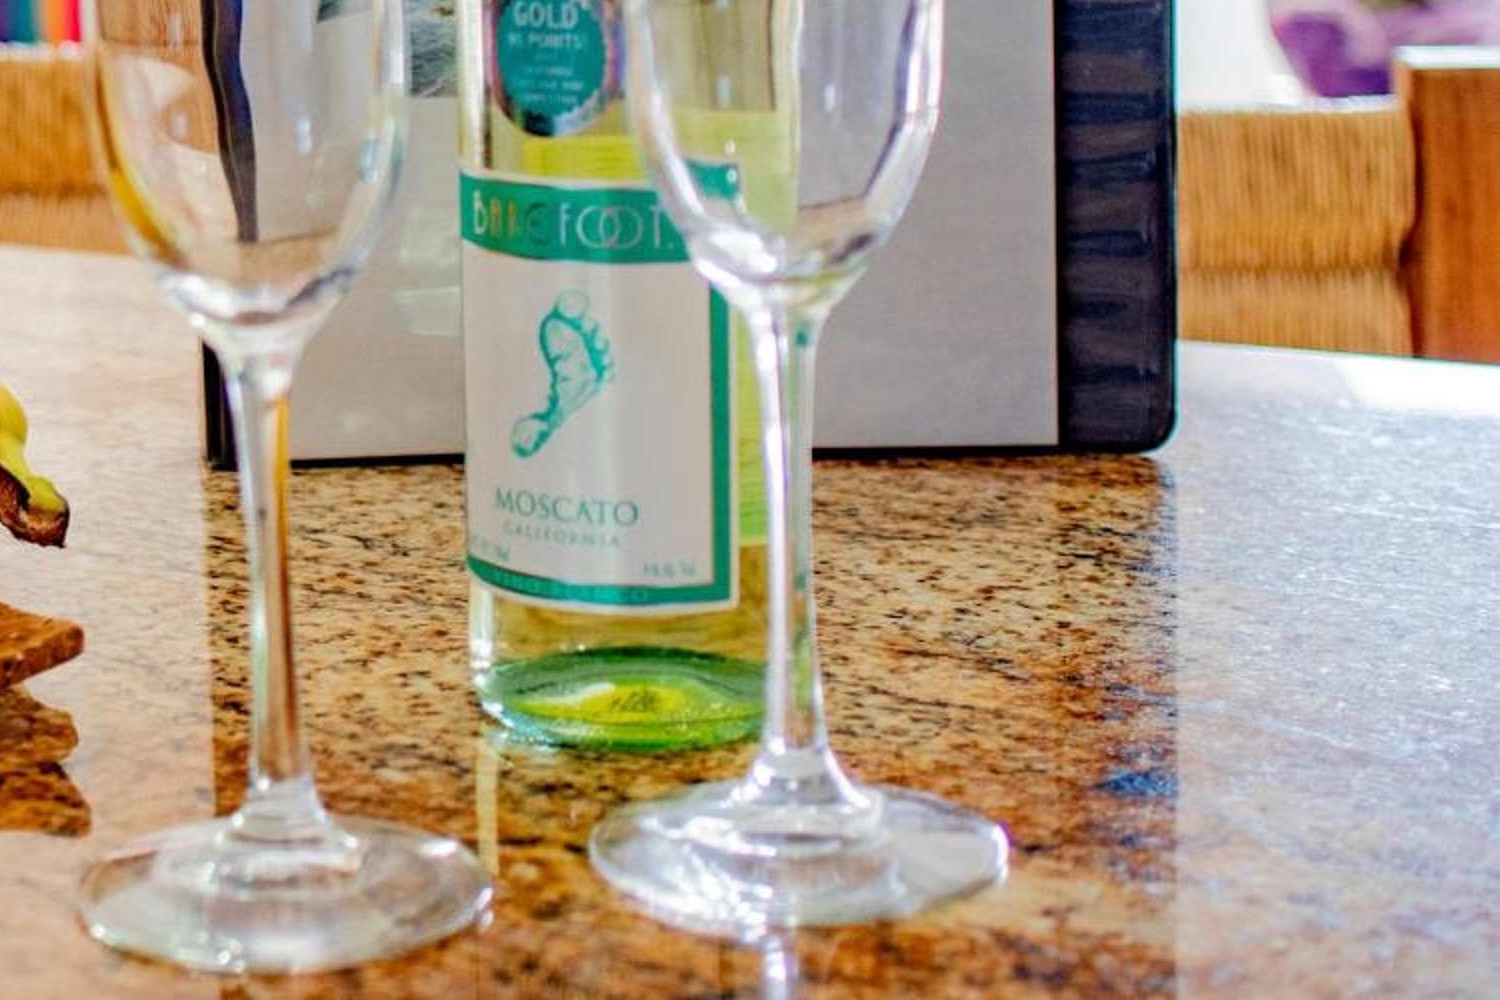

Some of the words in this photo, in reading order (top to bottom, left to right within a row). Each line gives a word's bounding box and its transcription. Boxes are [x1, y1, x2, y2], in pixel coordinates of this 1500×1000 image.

[513, 1, 580, 28] GOLD
[494, 487, 639, 527] MOSCATO
[502, 521, 622, 548] CALIFORNIA
